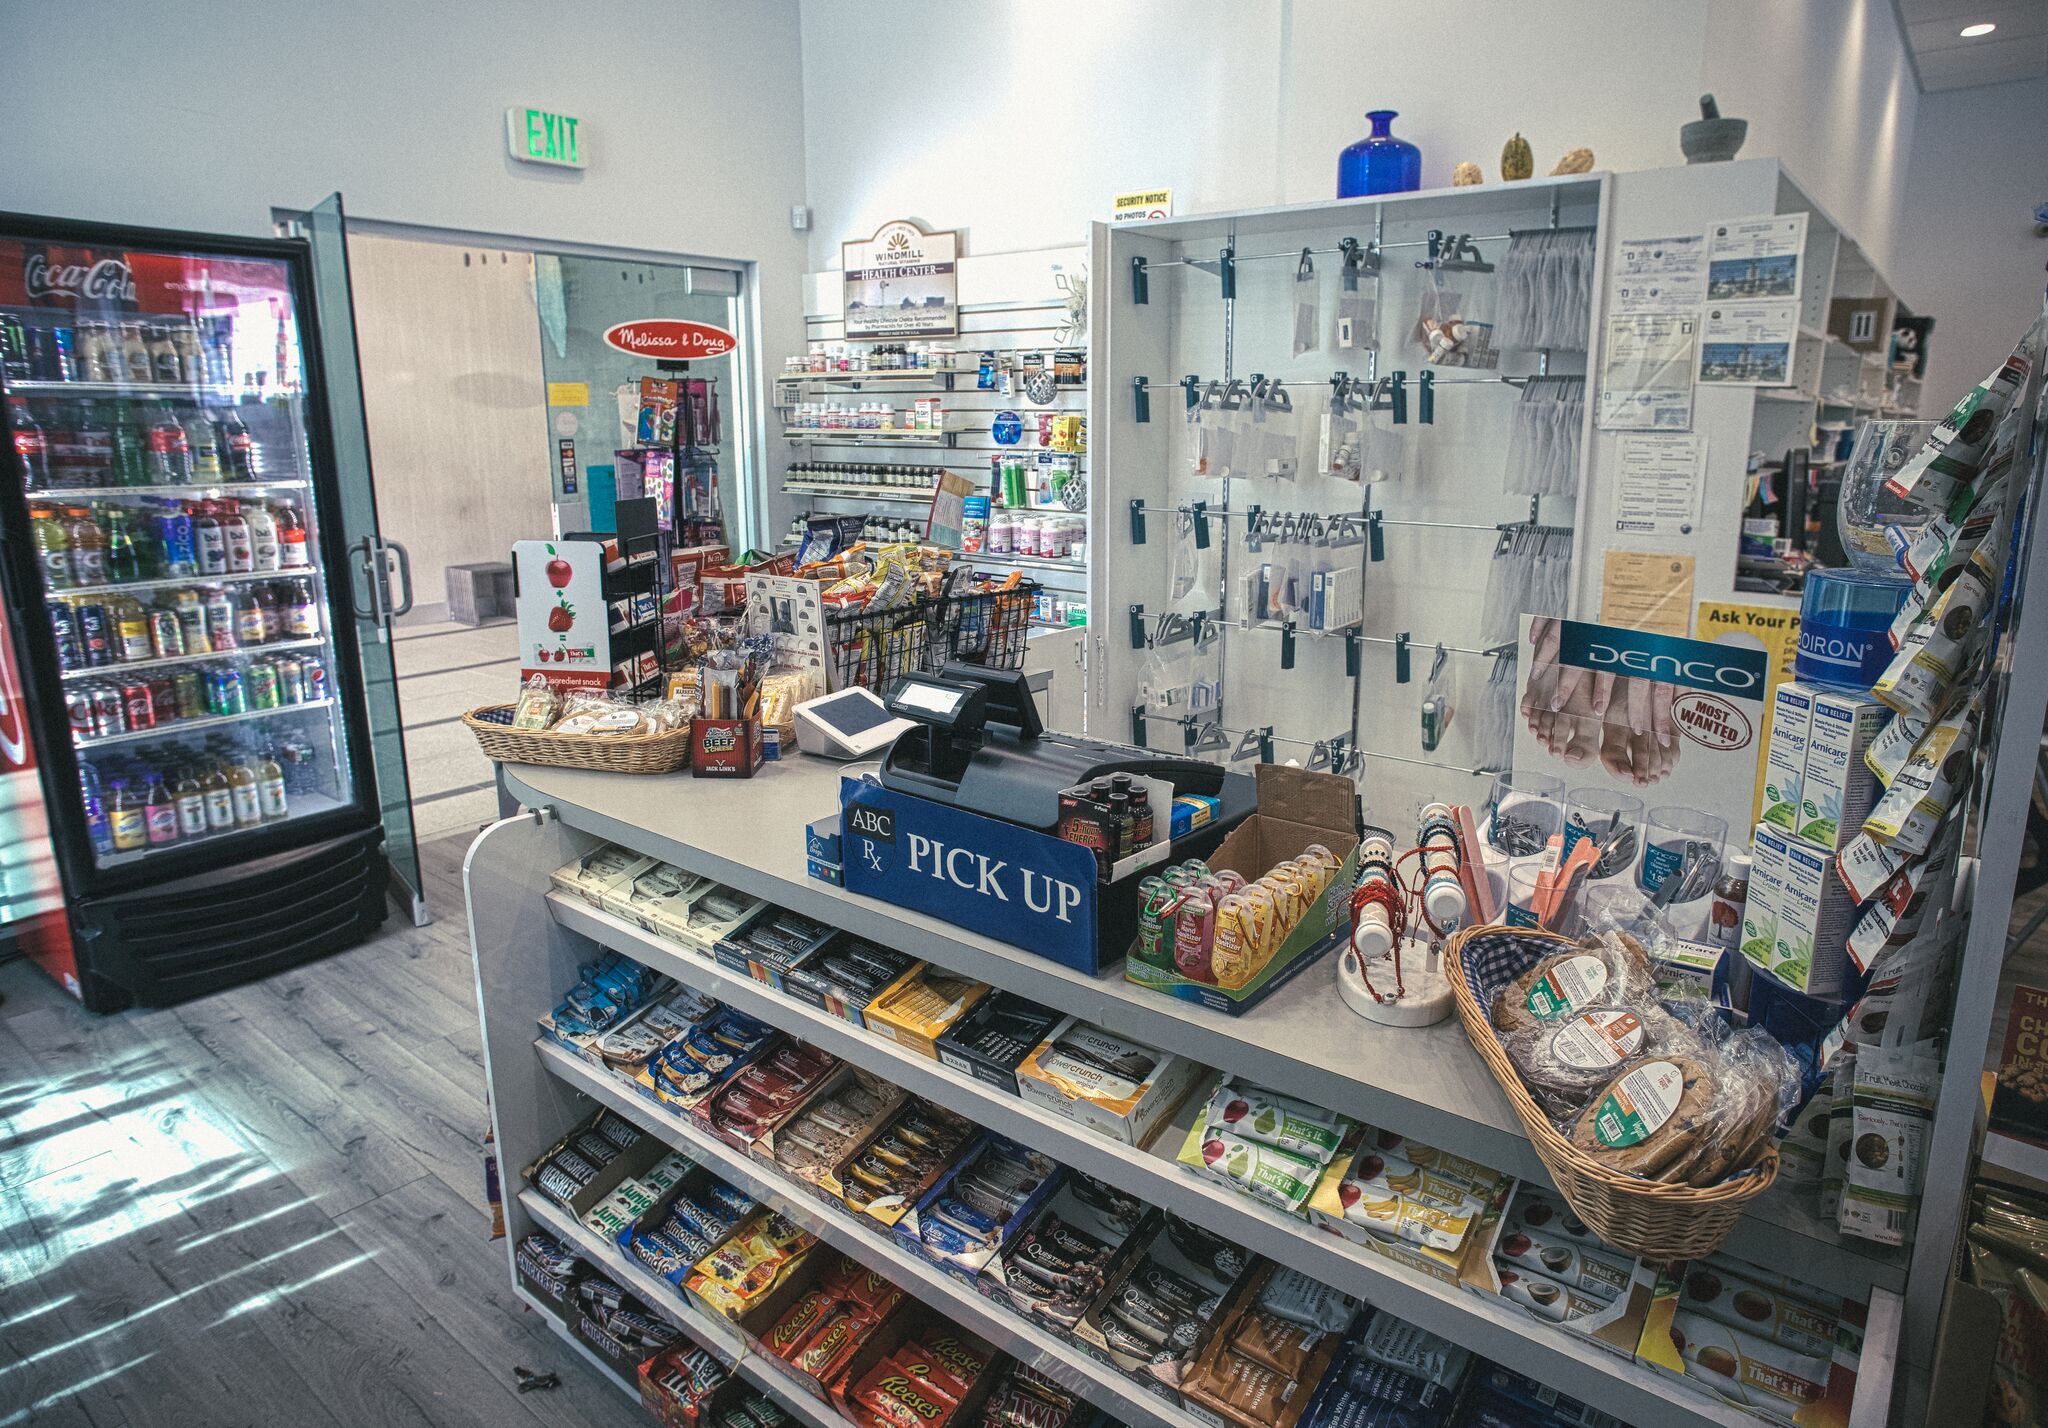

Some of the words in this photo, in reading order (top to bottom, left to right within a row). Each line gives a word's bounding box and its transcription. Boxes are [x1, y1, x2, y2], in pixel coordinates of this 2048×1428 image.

[526, 109, 578, 163] EXIT
[1116, 195, 1144, 208] SECURITY
[1145, 192, 1168, 204] NOTICE
[1115, 213, 1124, 221] NO
[1124, 210, 1147, 220] PHOTOS
[1343, 239, 1351, 248] C
[875, 250, 924, 261] WINDMILL
[25, 254, 136, 299] Coca-Cola
[861, 268, 897, 280] HEALTH
[899, 265, 937, 278] CENTER
[618, 328, 677, 349] Melissa
[682, 335, 688, 346] &
[692, 333, 726, 354] Doug
[1135, 377, 1140, 385] E
[1186, 376, 1191, 384] F
[1421, 370, 1427, 379] J
[1132, 500, 1137, 508] K
[1193, 612, 1199, 620] P
[1709, 609, 1741, 625] Ask
[1745, 612, 1786, 629] Your
[1397, 633, 1403, 642] S
[1589, 644, 1756, 689] DENCO
[891, 702, 909, 711] CASIO
[1695, 700, 1732, 723] MOST
[1790, 696, 1805, 707] RELIEF
[1185, 715, 1191, 723] U
[1829, 708, 1847, 720] RELIEF
[1260, 729, 1267, 737] W
[1680, 709, 1739, 743] WANTED
[1772, 726, 1804, 744] Arnicare
[703, 738, 736, 749] BEEF
[710, 745, 734, 753] CHEESE
[1793, 742, 1804, 753] Gel
[1810, 740, 1848, 759] Arnicare
[1333, 757, 1338, 765] Z
[1833, 757, 1846, 767] Gel
[852, 807, 891, 837] ABC
[1069, 832, 1098, 846] ENERGY
[1768, 838, 1784, 853] RELIEF
[862, 838, 883, 872] Rx
[1802, 854, 1820, 870] RELIEF
[906, 832, 1010, 903] PICK
[1020, 866, 1082, 924] UP
[1751, 864, 1783, 887] Arnicare
[1762, 879, 1781, 893] Cream
[1784, 882, 1817, 907] Arnicare
[1796, 898, 1816, 913] Cream
[1176, 928, 1202, 942] Sanitizer
[1180, 925, 1196, 935] Hand
[1220, 931, 1237, 943] Hand
[1215, 935, 1242, 951] Sanitizer
[865, 964, 891, 981] KIND
[944, 1055, 969, 1072] RXBAR
[1075, 1079, 1097, 1091] original
[728, 1090, 750, 1105] QUEST
[1026, 1086, 1074, 1110] powercrunch
[600, 1111, 642, 1148] HERSHEY'S
[1285, 1121, 1312, 1139] That's
[1311, 1129, 1324, 1142] it.
[554, 1150, 600, 1186] HERSHEY'S
[863, 1154, 901, 1180] QUESTBAR
[538, 1165, 584, 1201] HERSHEY'S
[1257, 1165, 1282, 1186] That's
[1281, 1178, 1293, 1192] it.
[617, 1183, 653, 1209] Junio
[1427, 1181, 1460, 1201] That's
[673, 1195, 709, 1226] Almond
[703, 1219, 727, 1241] Joy
[1406, 1204, 1439, 1226] That's
[1438, 1214, 1450, 1229] it.
[920, 1221, 960, 1246] QUESTBAR
[712, 1248, 749, 1275] Raisinets
[1026, 1242, 1072, 1271] QUESTBAR
[1385, 1247, 1432, 1276] That's
[517, 1250, 554, 1293] SNICKERS
[1006, 1265, 1053, 1295] QUESTBAR
[1585, 1260, 1621, 1284] That's
[1146, 1270, 1194, 1300] QUESTBAR
[1123, 1289, 1171, 1323] QUESTBAR
[772, 1296, 819, 1348] Reese's
[1784, 1308, 1826, 1336] That's
[580, 1316, 621, 1358] SNICKERS
[1101, 1320, 1150, 1350] QUESTBAR
[800, 1321, 848, 1372] Reese's
[1748, 1363, 1788, 1392] That's
[1791, 1375, 1807, 1399] it.
[878, 1375, 943, 1420] Reese's
[1190, 1405, 1220, 1425] RXBAR
